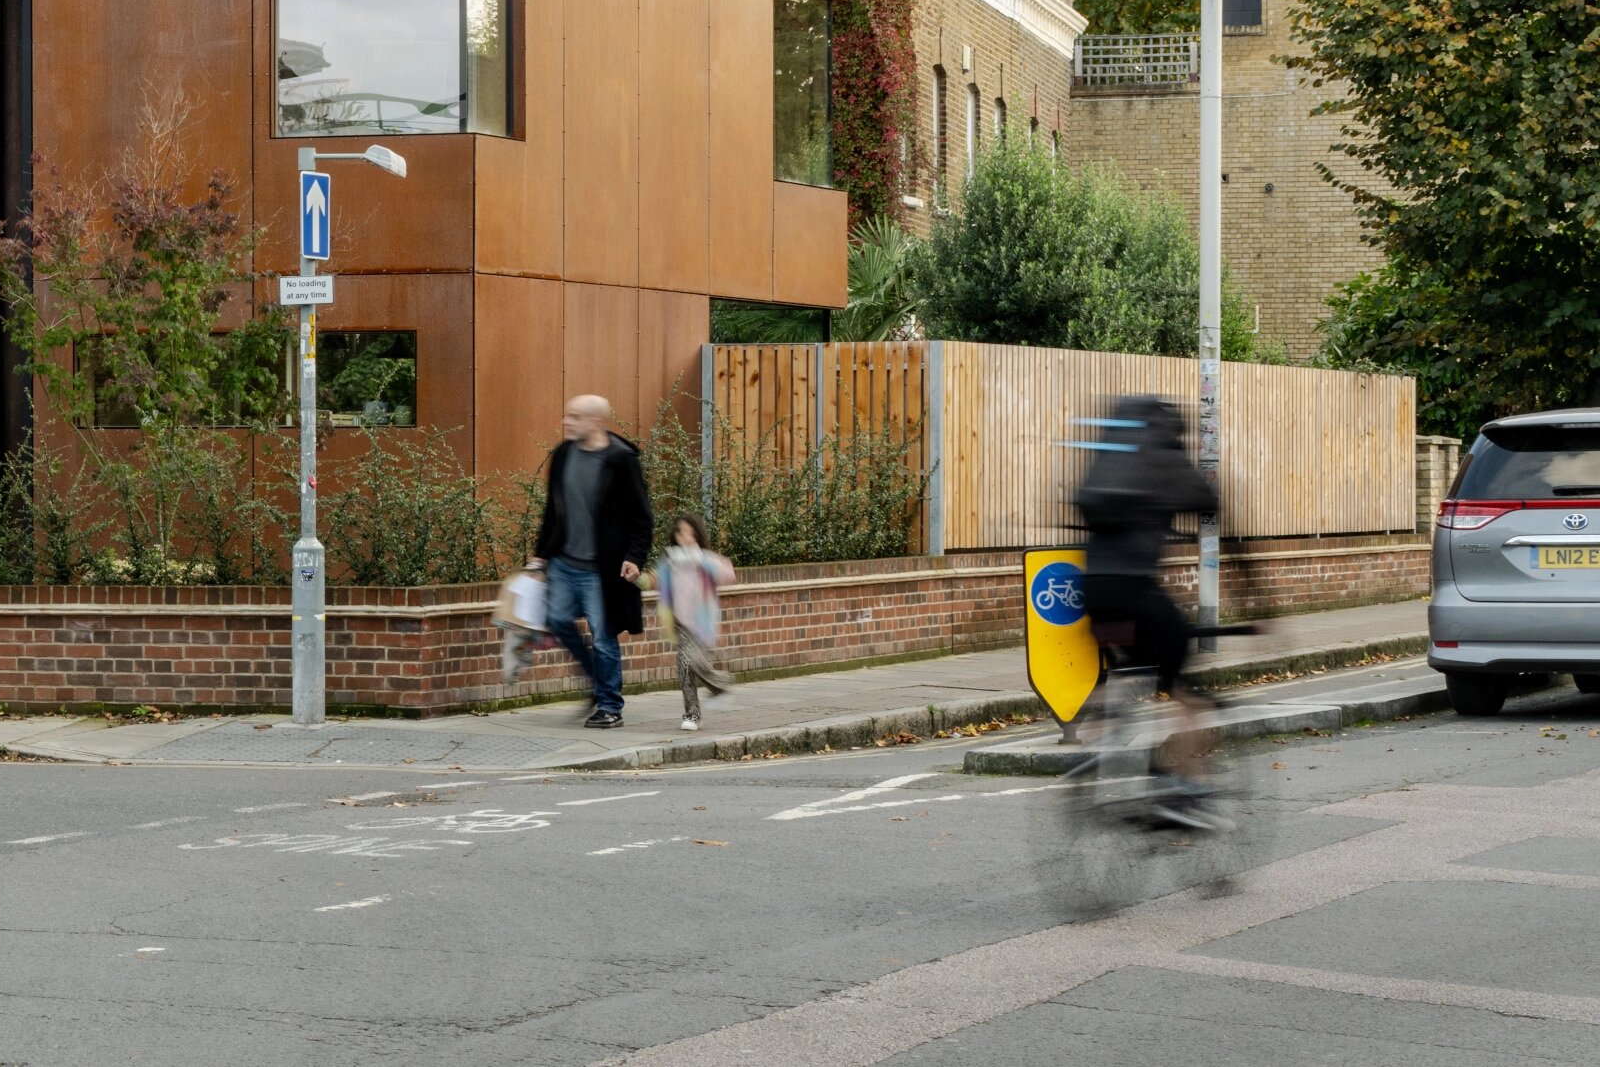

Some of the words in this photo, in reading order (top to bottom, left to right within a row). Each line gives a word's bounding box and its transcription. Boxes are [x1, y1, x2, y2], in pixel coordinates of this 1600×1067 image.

[298, 280, 327, 288] loading
[286, 292, 294, 300] at
[295, 292, 309, 300] any
[310, 291, 327, 299] time
[1545, 549, 1584, 565] LN12
[177, 833, 474, 858] SPINE
